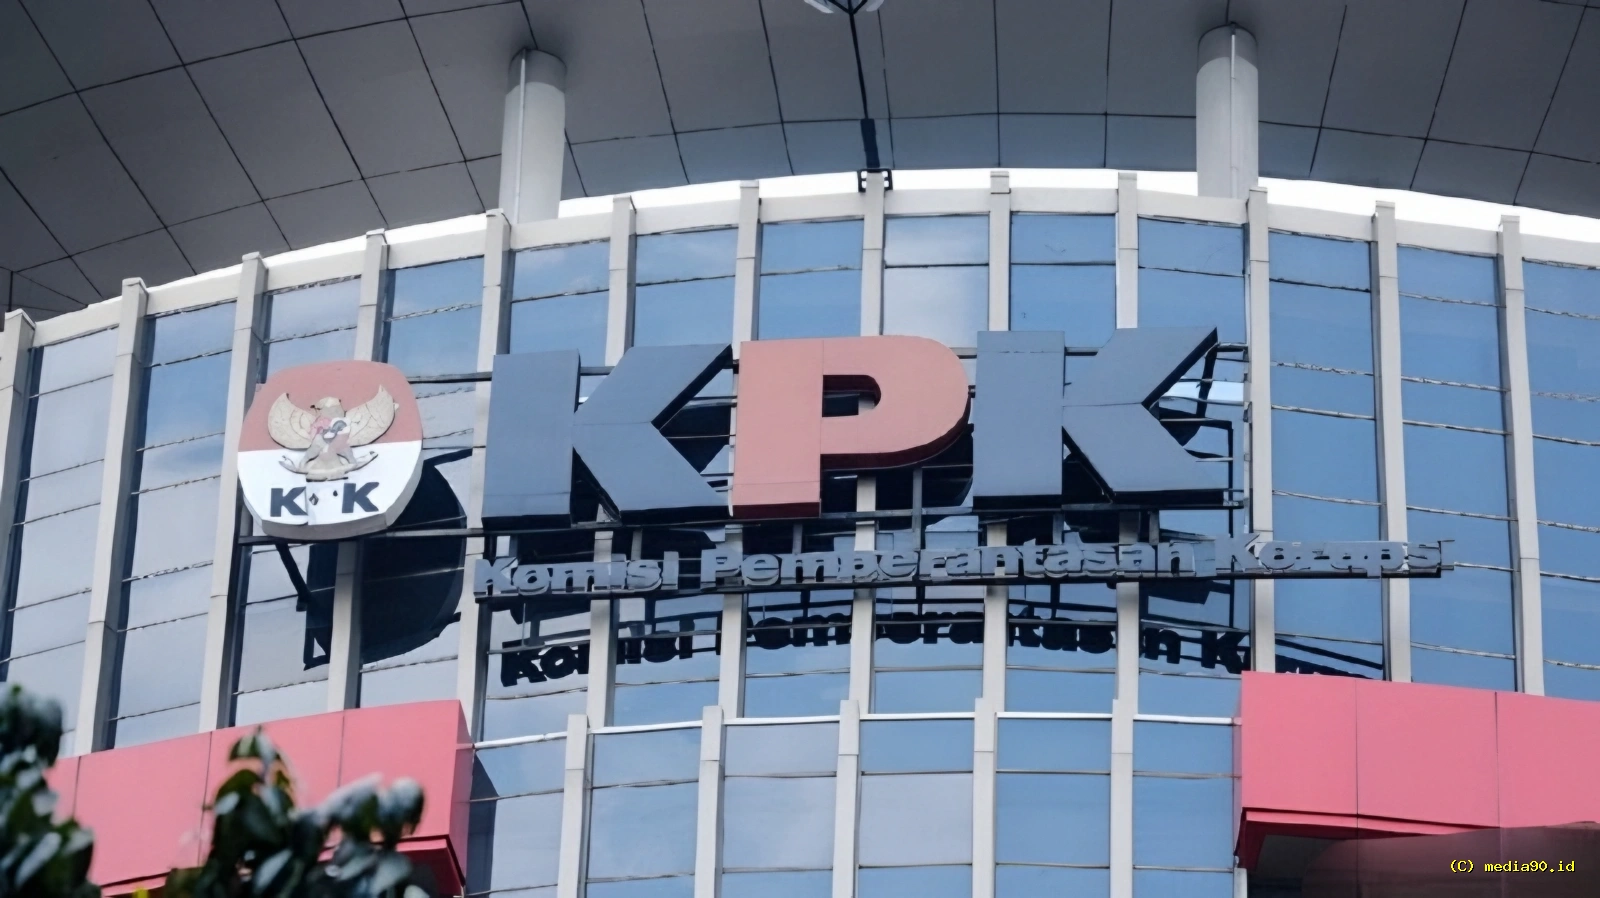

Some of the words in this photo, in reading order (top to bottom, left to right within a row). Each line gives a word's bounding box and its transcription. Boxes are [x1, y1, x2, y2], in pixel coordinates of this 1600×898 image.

[482, 327, 1225, 526] KPK
[270, 481, 379, 518] KK
[474, 551, 679, 597] Komisi
[700, 538, 1197, 588] Pemberantasan
